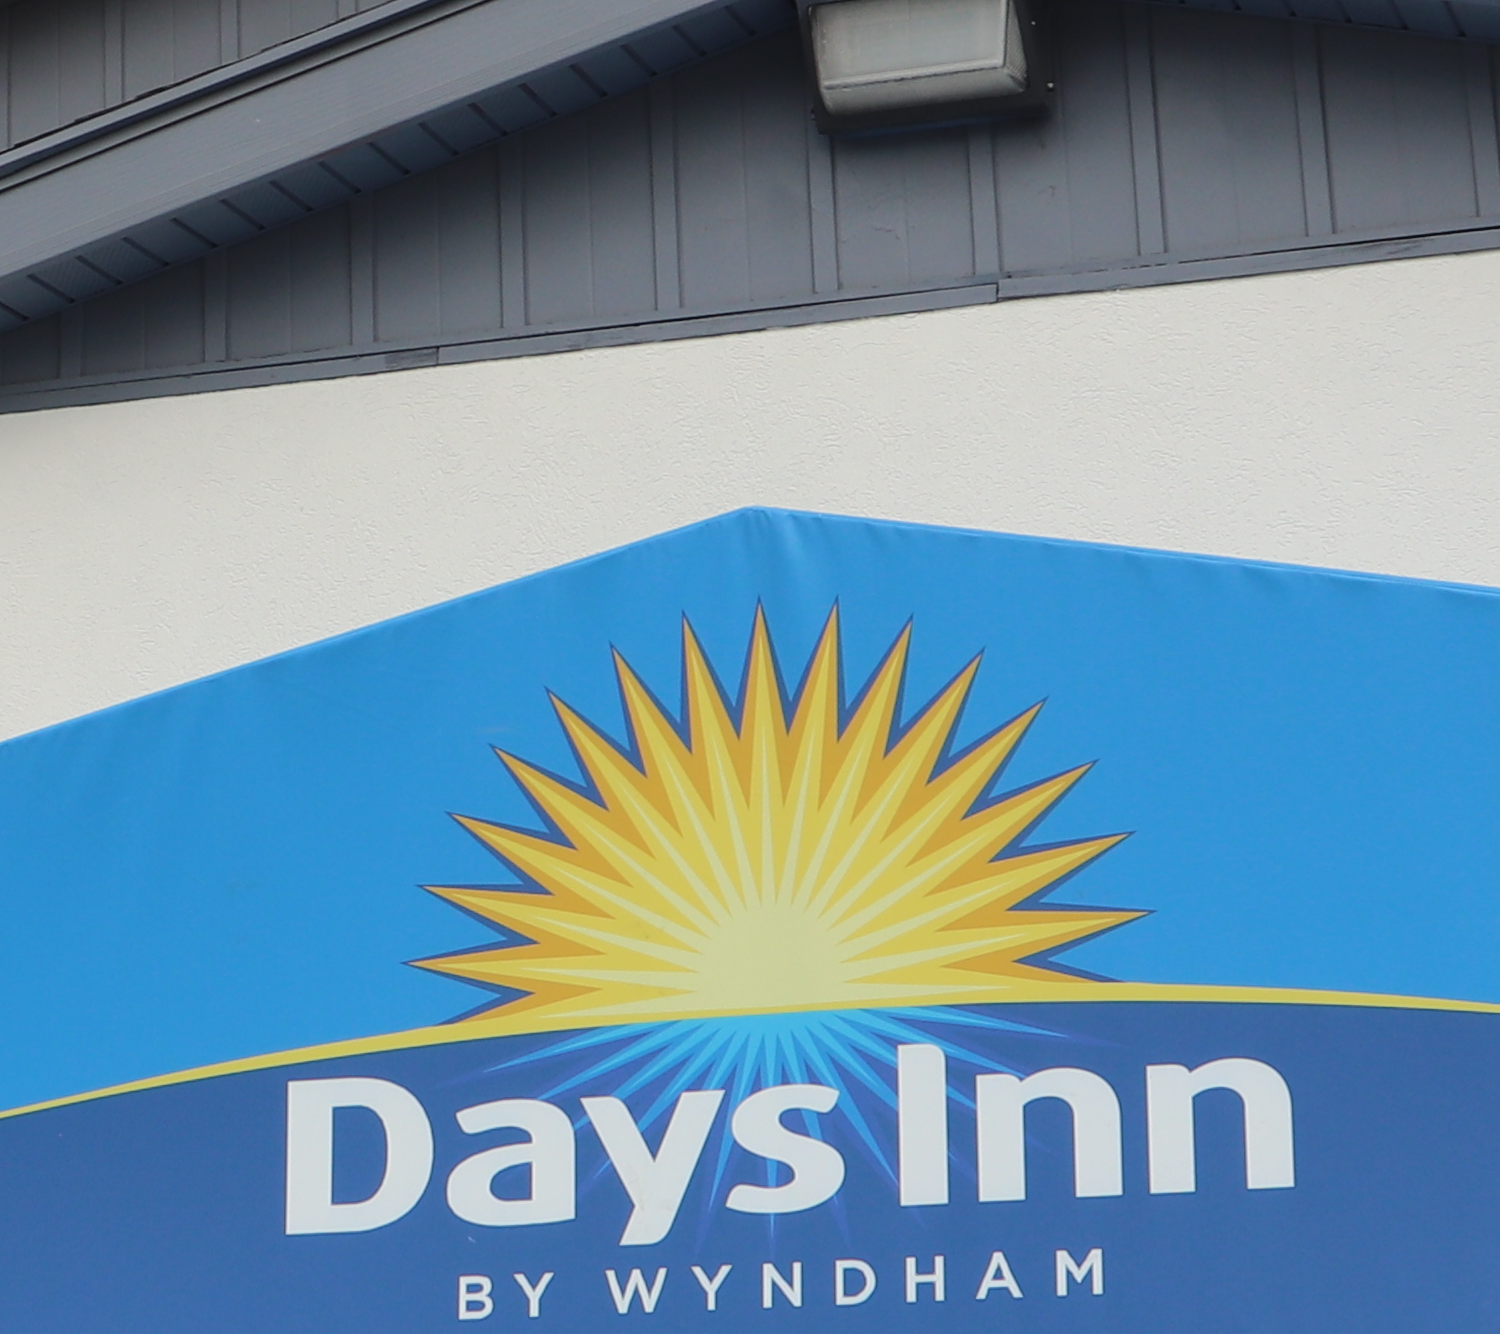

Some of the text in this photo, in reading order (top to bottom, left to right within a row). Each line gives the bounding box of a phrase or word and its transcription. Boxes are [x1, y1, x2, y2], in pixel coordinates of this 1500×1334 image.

[285, 1043, 1295, 1246] Days Inn
[458, 1248, 1104, 1320] BY WYNDHAM
